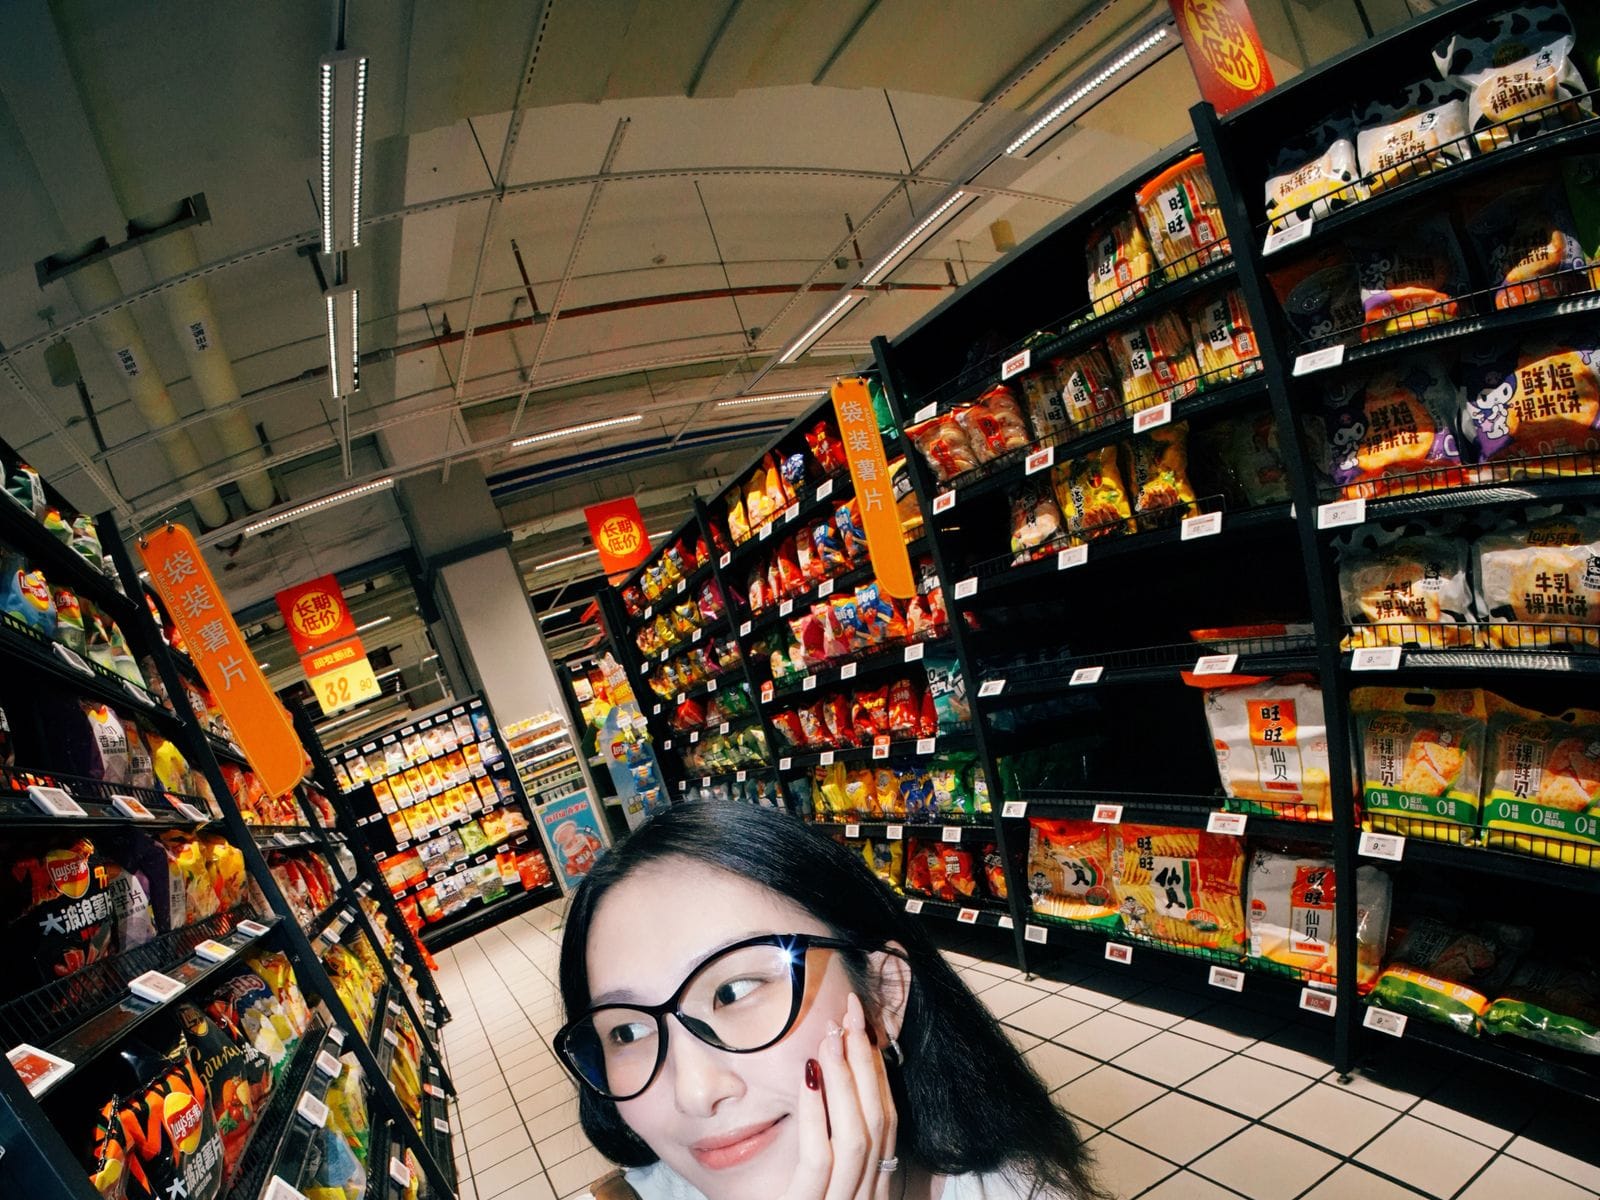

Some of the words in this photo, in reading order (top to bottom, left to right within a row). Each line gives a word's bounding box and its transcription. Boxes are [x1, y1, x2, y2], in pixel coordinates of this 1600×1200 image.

[1189, 0, 1245, 47] 长期
[1202, 33, 1256, 85] 低价
[1491, 76, 1547, 113] 裸米饼
[1497, 73, 1532, 89] 牛乳
[1378, 142, 1425, 169] 裸米饼
[1387, 130, 1415, 147] 牛乳
[1168, 193, 1186, 234] 旺旺
[1210, 308, 1228, 342] 旺旺
[1130, 336, 1148, 371] 旺旺
[1521, 363, 1576, 396] 鲜焙
[1370, 401, 1416, 432] 鲜焙
[1514, 390, 1582, 424] 裸米饼
[840, 400, 883, 512] 袋装薯片
[1365, 424, 1420, 456] 裸米饼
[603, 520, 633, 538] 长期
[608, 534, 637, 553] 低价
[1385, 581, 1414, 599] 牛乳
[1535, 573, 1574, 594] 牛乳
[163, 550, 247, 691] 袋装薯片
[296, 593, 332, 618] 长期
[302, 609, 336, 634] 低价
[1375, 598, 1428, 620] 裸米饼
[1524, 593, 1588, 618] 裸米饼
[325, 676, 351, 707] 32
[1261, 705, 1284, 743] 旺旺
[1270, 747, 1288, 782] 仙贝
[1379, 738, 1395, 788] 裸鲜贝
[1513, 743, 1533, 799] 裸鲜贝
[1136, 835, 1154, 871] 旺旺
[1303, 870, 1326, 906] 旺旺
[1305, 909, 1320, 943] 仙贝
